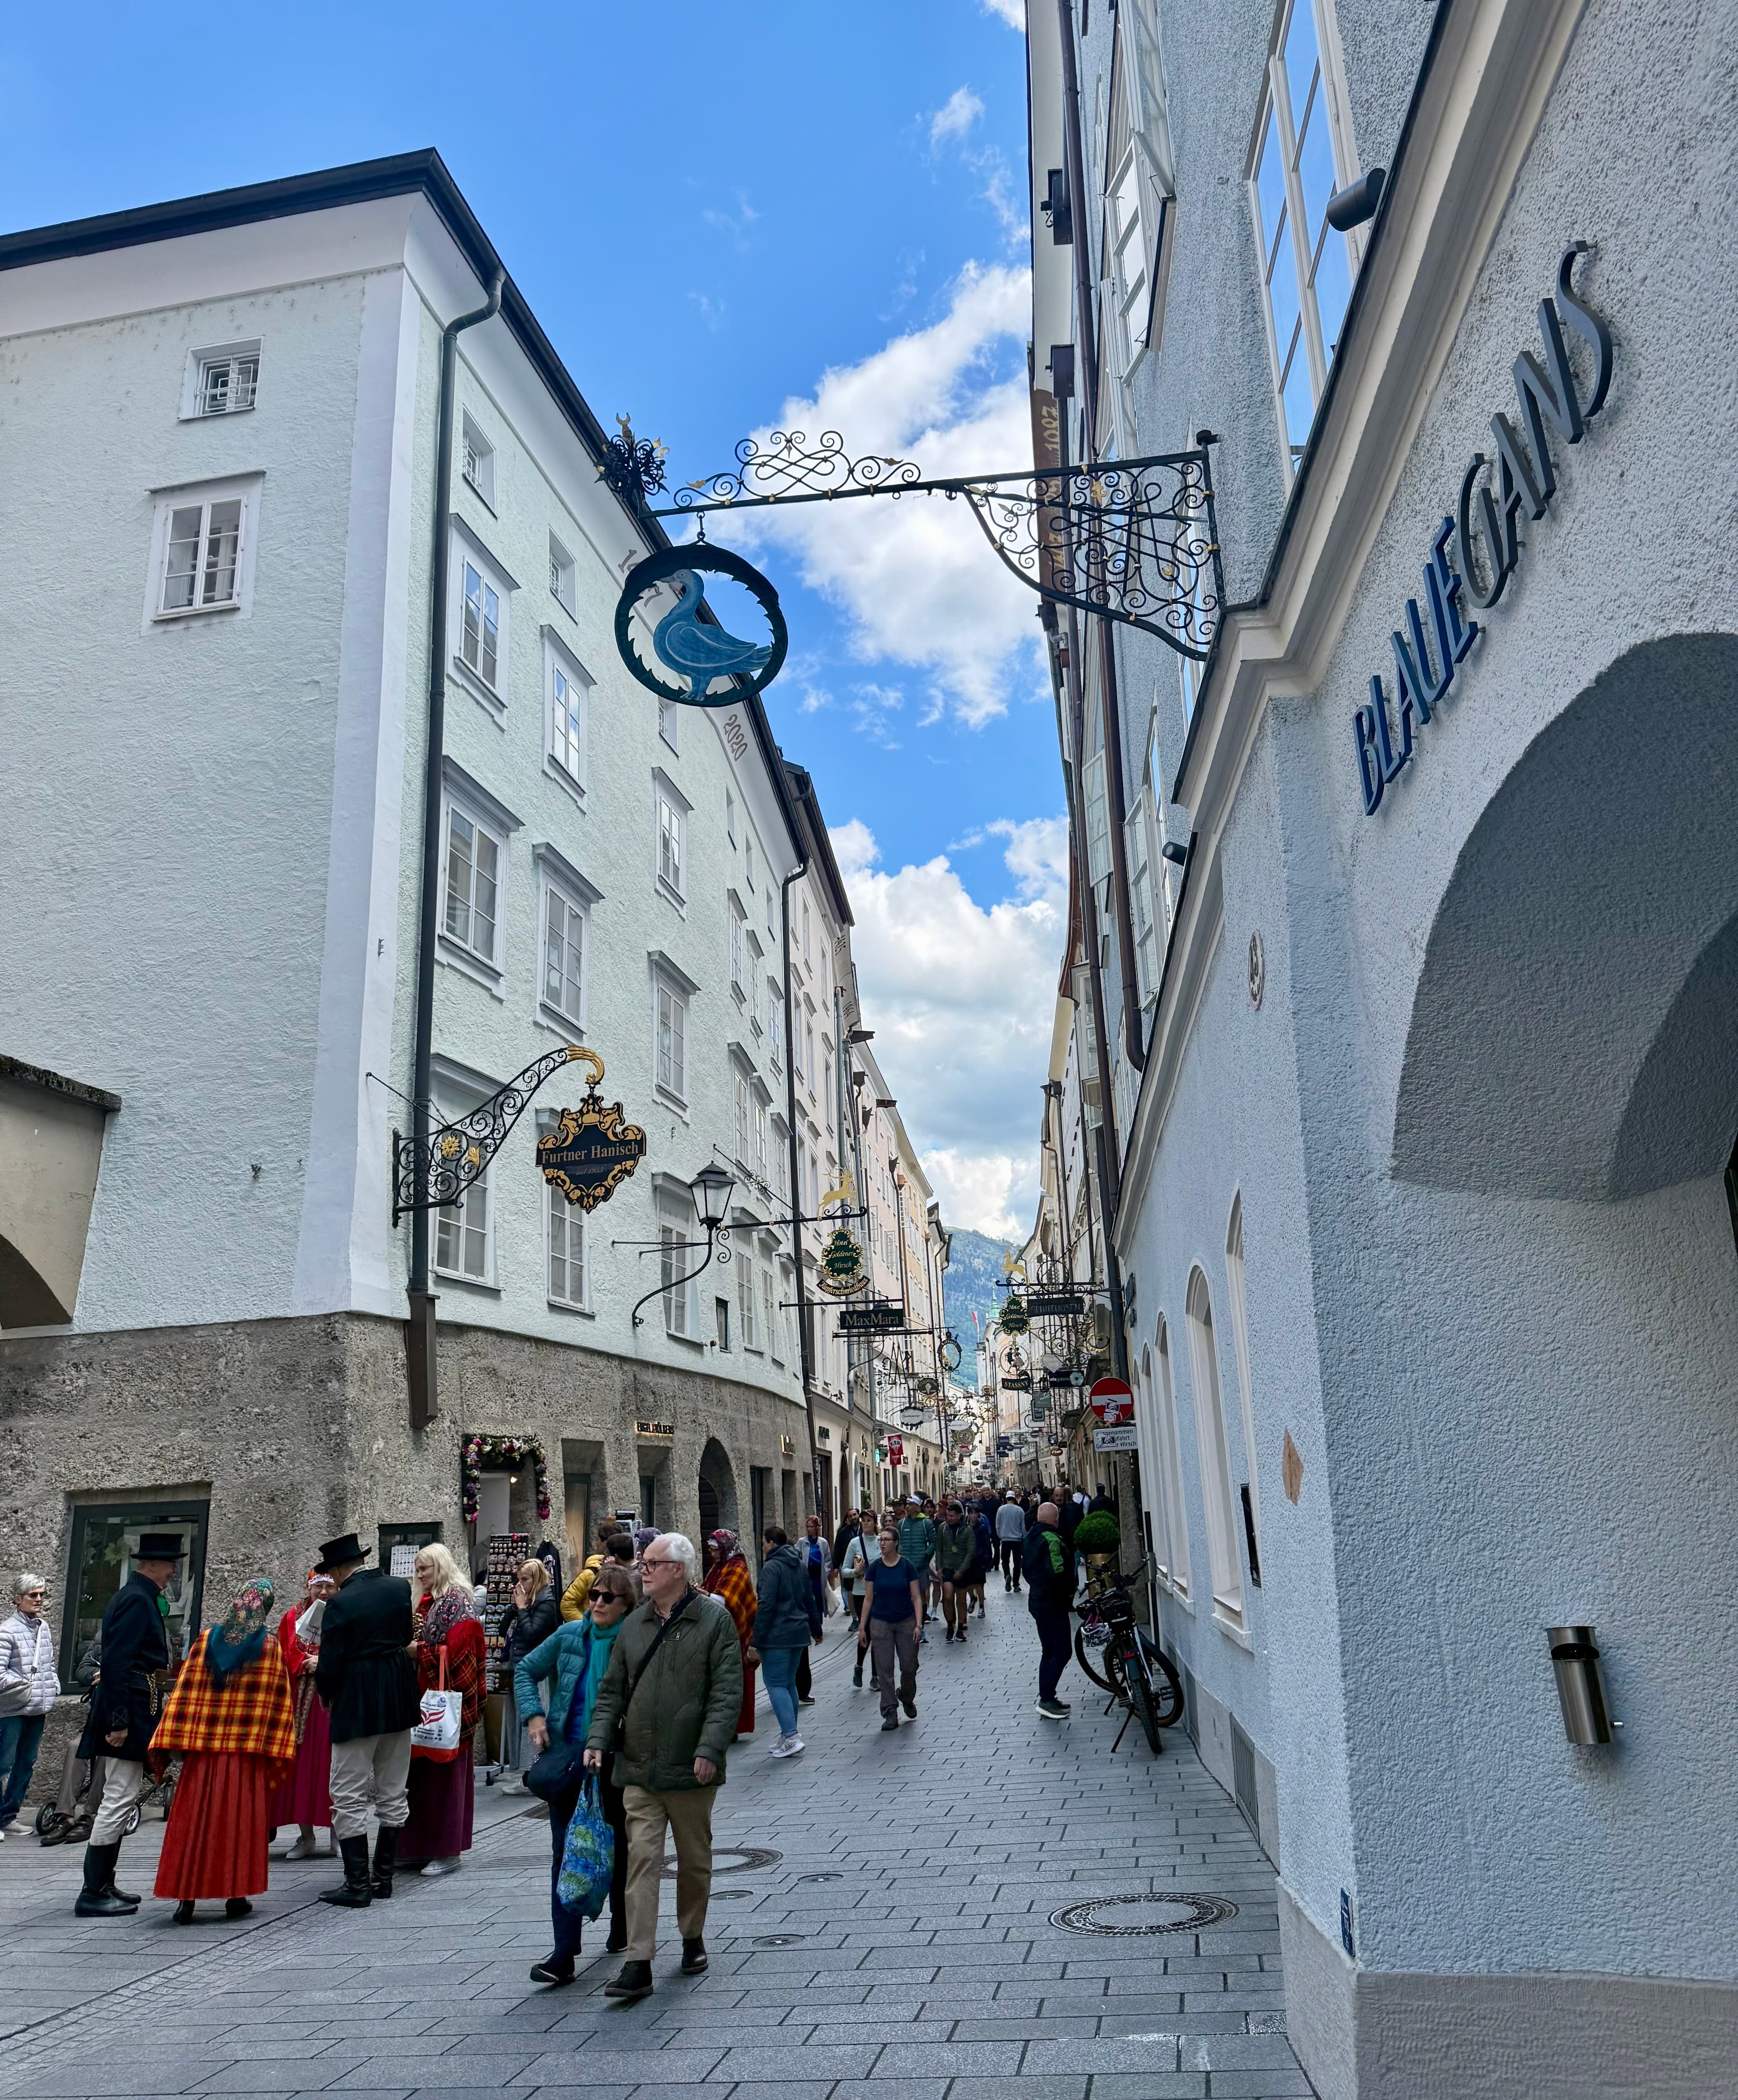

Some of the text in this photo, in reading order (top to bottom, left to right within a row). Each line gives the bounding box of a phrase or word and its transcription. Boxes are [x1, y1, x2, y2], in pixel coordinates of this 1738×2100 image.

[723, 714, 748, 761] 2020
[843, 1001, 855, 1019] 1964
[541, 1141, 639, 1163] Furtner Hanisch
[818, 1277, 868, 1295] Kupferschmiedhaus
[1031, 1303, 1081, 1313] SPIRITUOSEN
[845, 1313, 899, 1326] MaxMara
